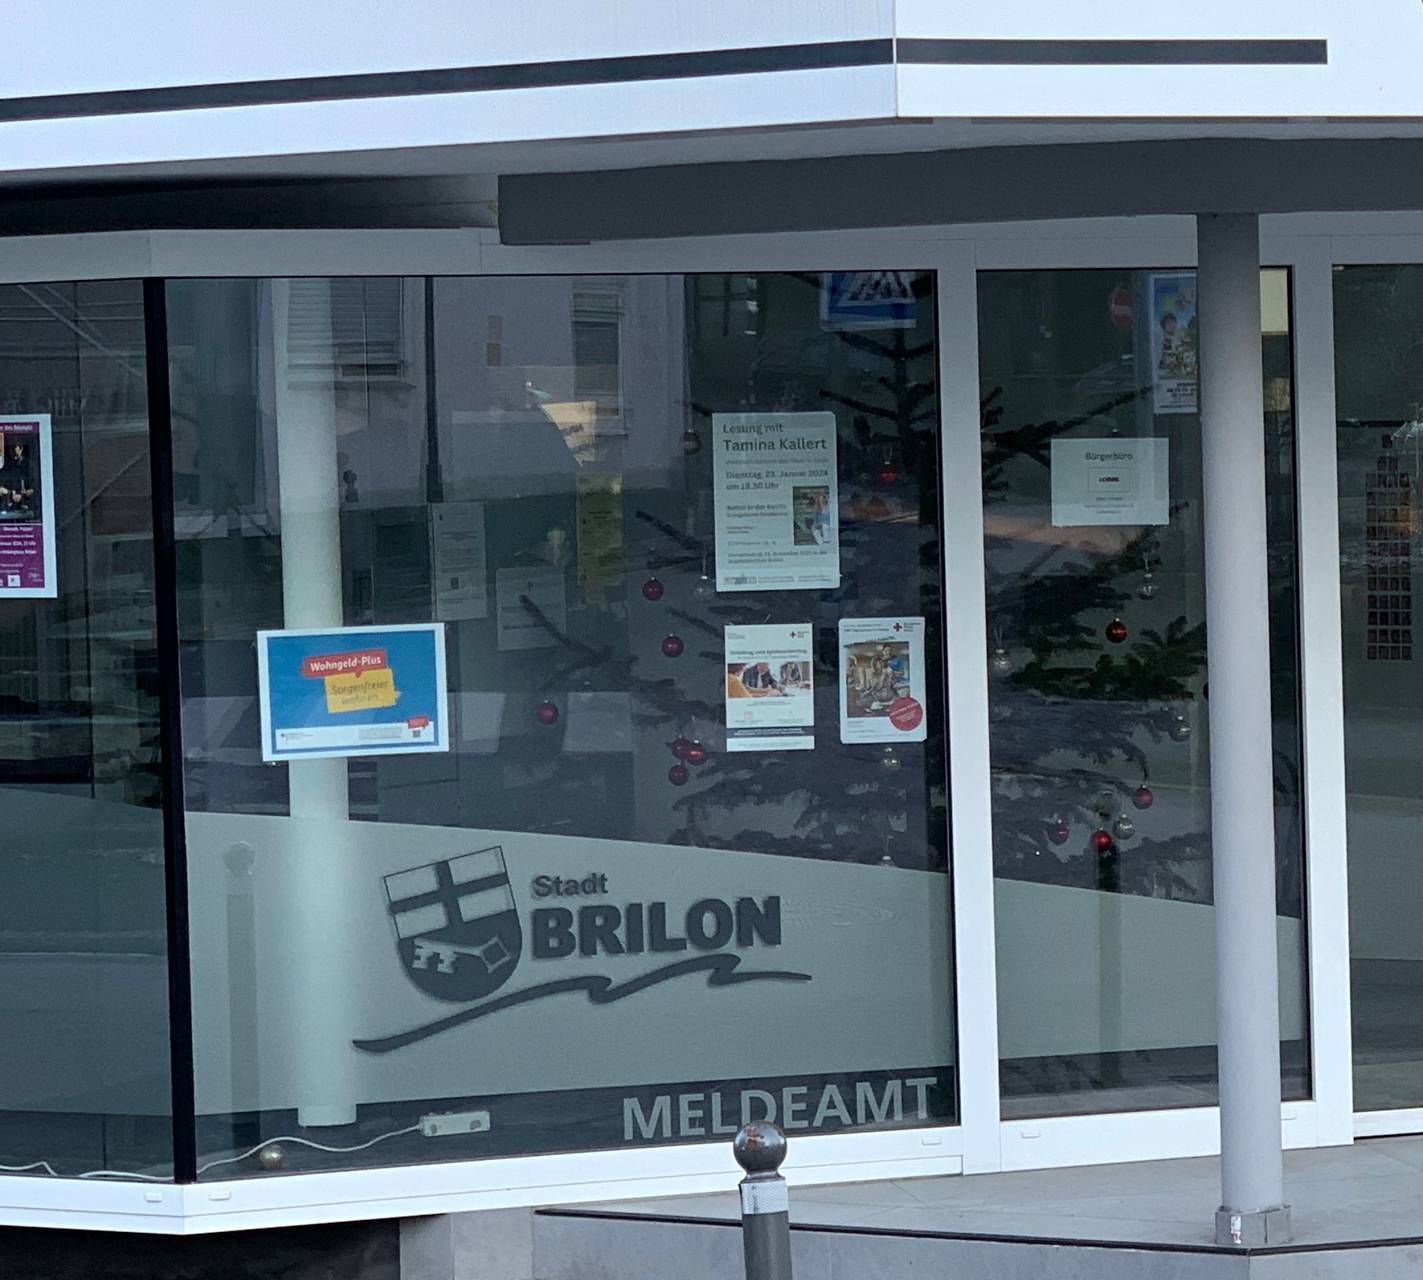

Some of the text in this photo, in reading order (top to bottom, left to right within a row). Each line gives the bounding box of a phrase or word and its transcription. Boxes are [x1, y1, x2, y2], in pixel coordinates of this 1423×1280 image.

[722, 422, 784, 435] Lesung mit
[723, 437, 828, 452] Tamina Kallert
[1085, 451, 1134, 462] Bürgerbüro
[808, 469, 828, 478] 2024
[310, 656, 382, 672] Wohngeld-Plus
[331, 681, 388, 696] Sorgenfreier
[532, 872, 609, 898] Stadt
[531, 895, 782, 958] BRILON
[622, 1077, 938, 1140] MELDEAMT
